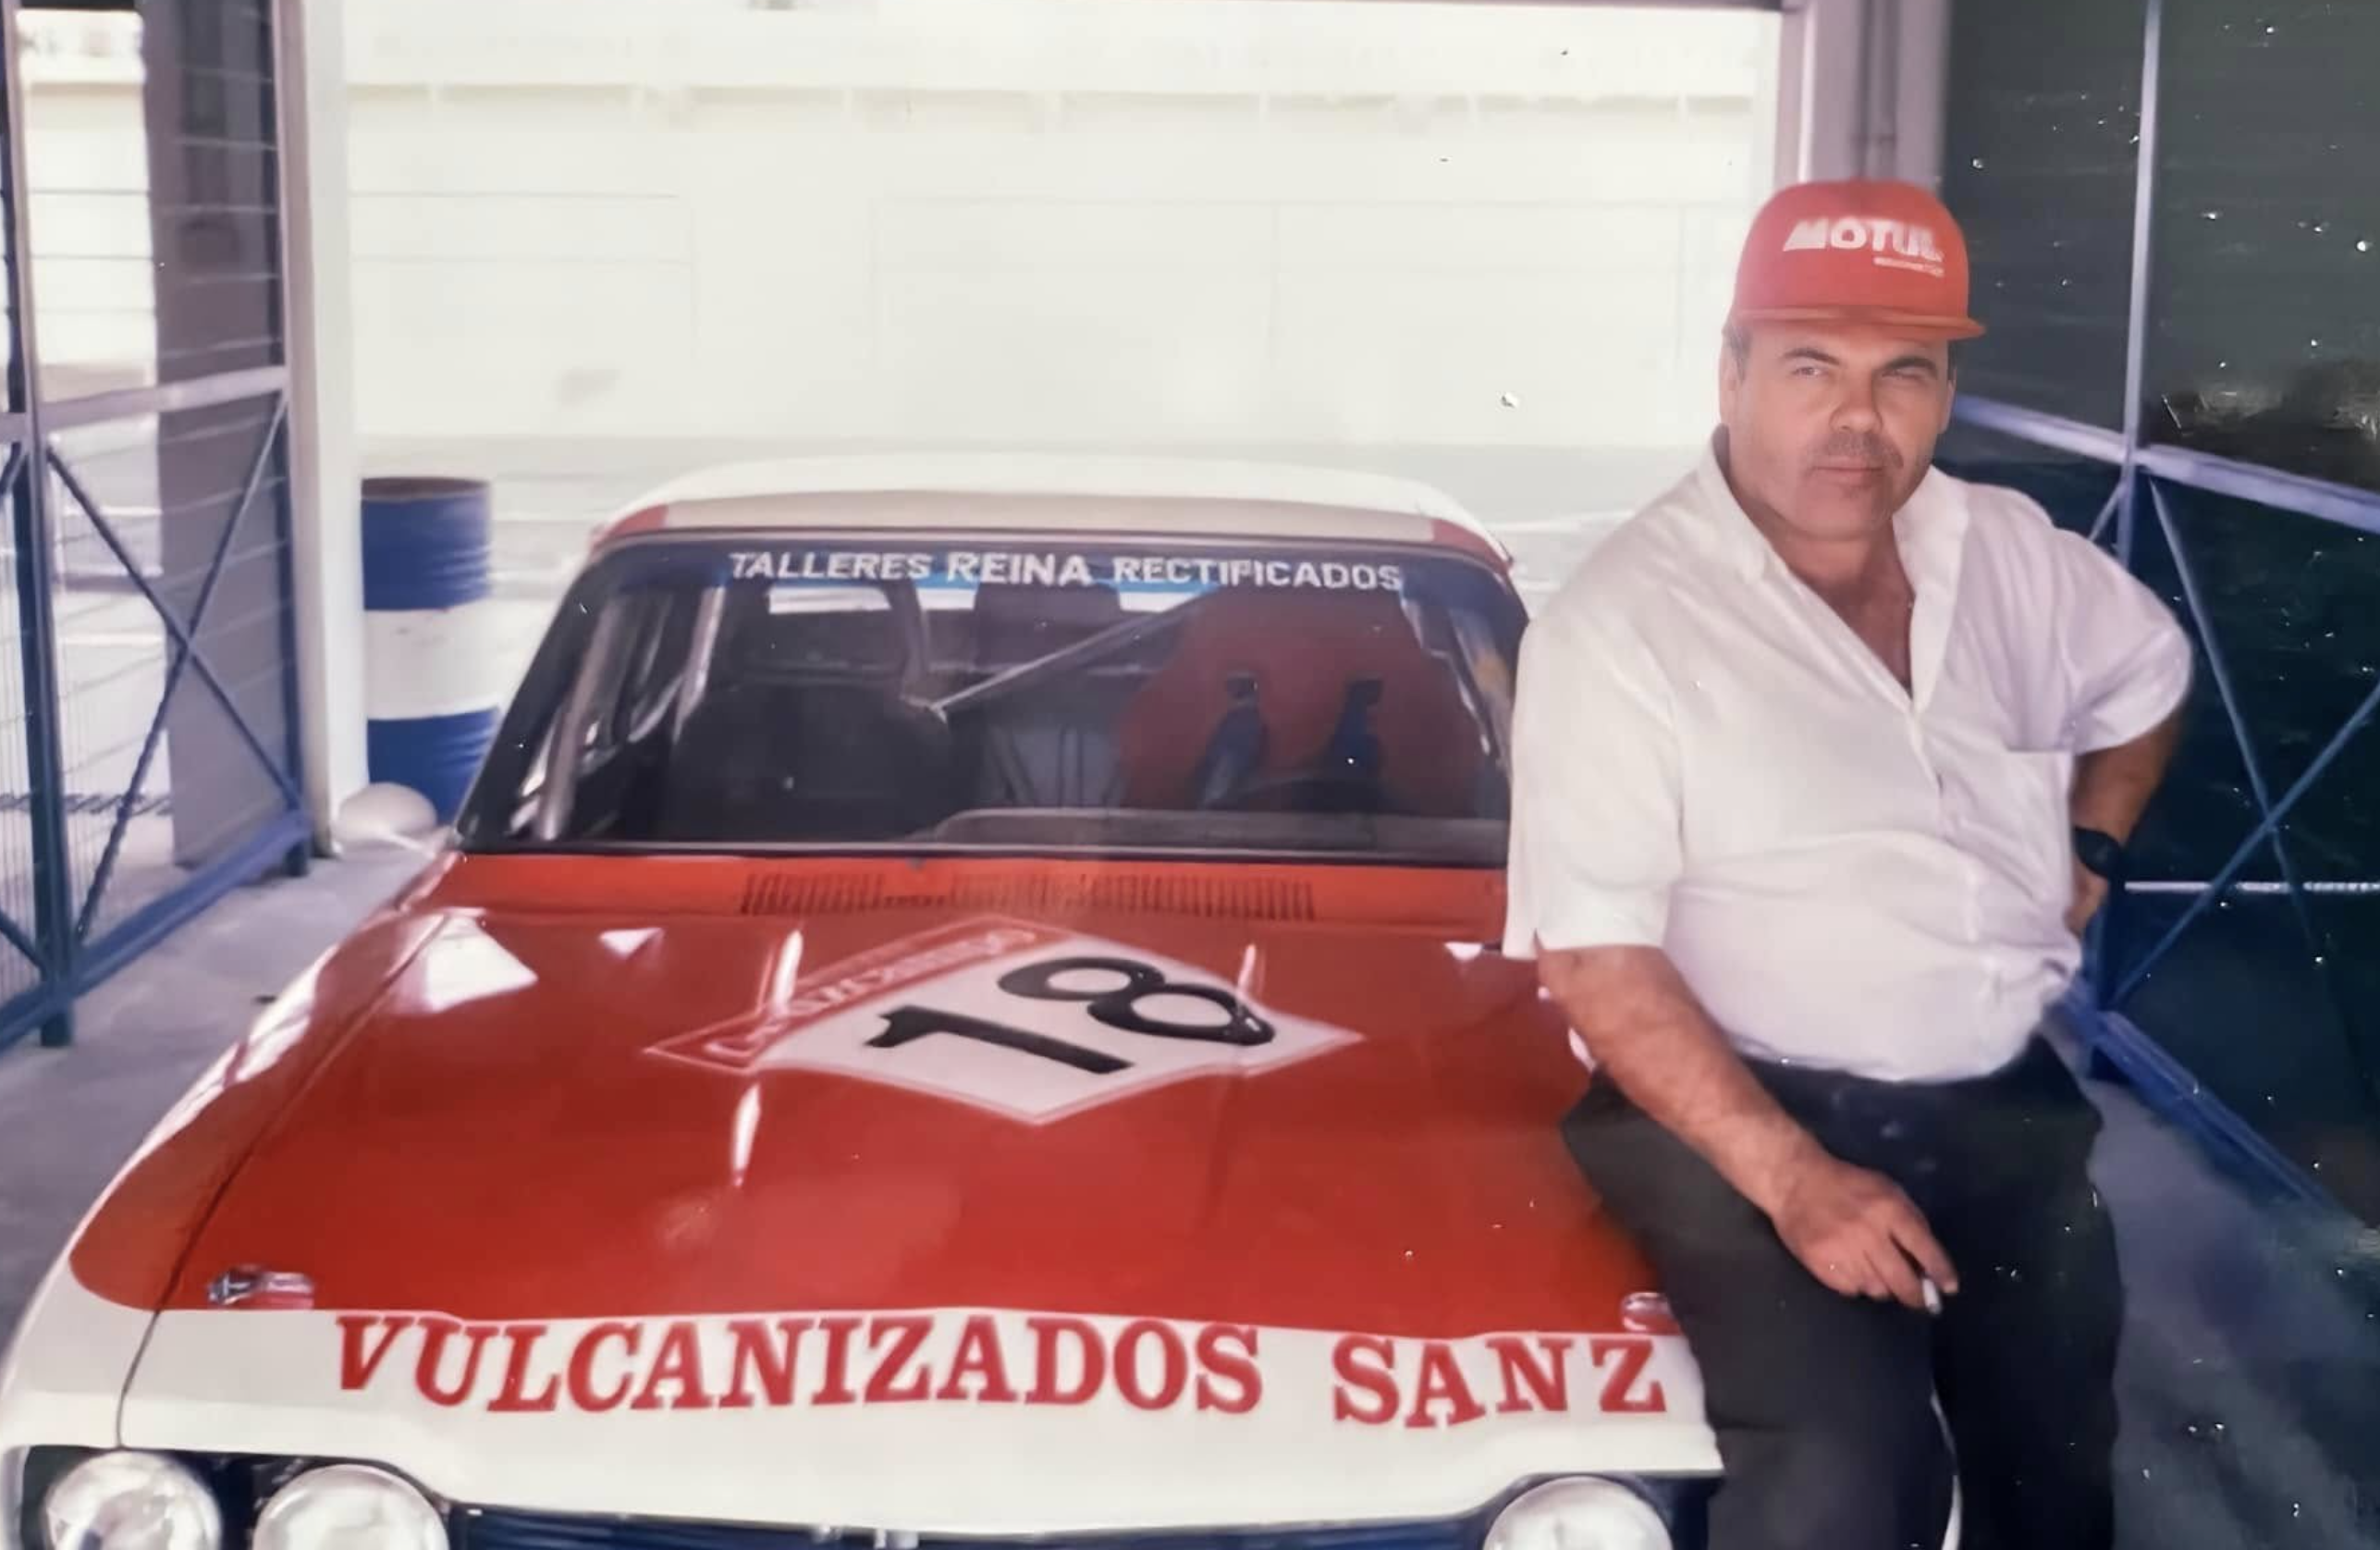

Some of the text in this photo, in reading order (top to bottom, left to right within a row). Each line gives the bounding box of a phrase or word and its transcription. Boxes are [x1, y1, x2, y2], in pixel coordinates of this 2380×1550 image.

[1783, 216, 1944, 263] MOTUL
[730, 551, 931, 581] TALLERES
[946, 552, 1093, 586] REINA
[865, 956, 1275, 1075] 18
[336, 1313, 1666, 1429] VULCANIZADOS SANZ
